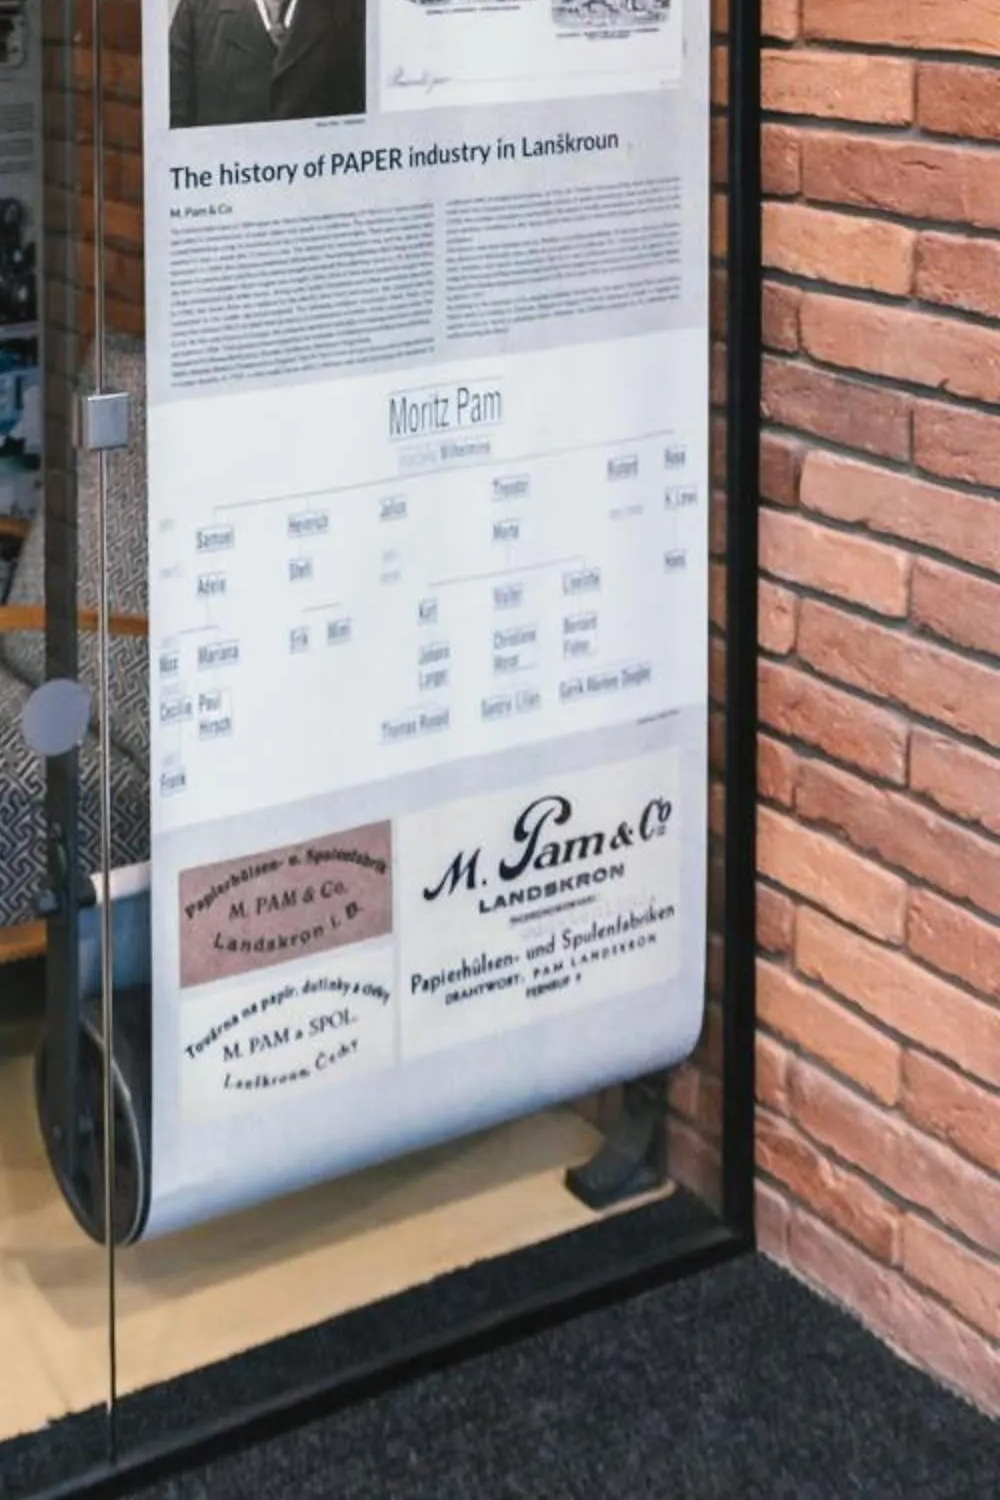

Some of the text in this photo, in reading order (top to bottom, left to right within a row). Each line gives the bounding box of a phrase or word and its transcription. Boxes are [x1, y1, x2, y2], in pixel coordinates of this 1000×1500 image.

[169, 132, 619, 190] The history of PAPER industry in Lanškroun
[388, 387, 501, 436] Moritz Pam
[423, 847, 487, 901] M.
[498, 795, 605, 881] Pam
[609, 821, 634, 850] &
[255, 889, 298, 915] PAM
[478, 863, 625, 914] LANDSKRON
[526, 936, 555, 961] und
[561, 905, 675, 951] Spulenfabriken
[249, 1028, 290, 1056] PAM
